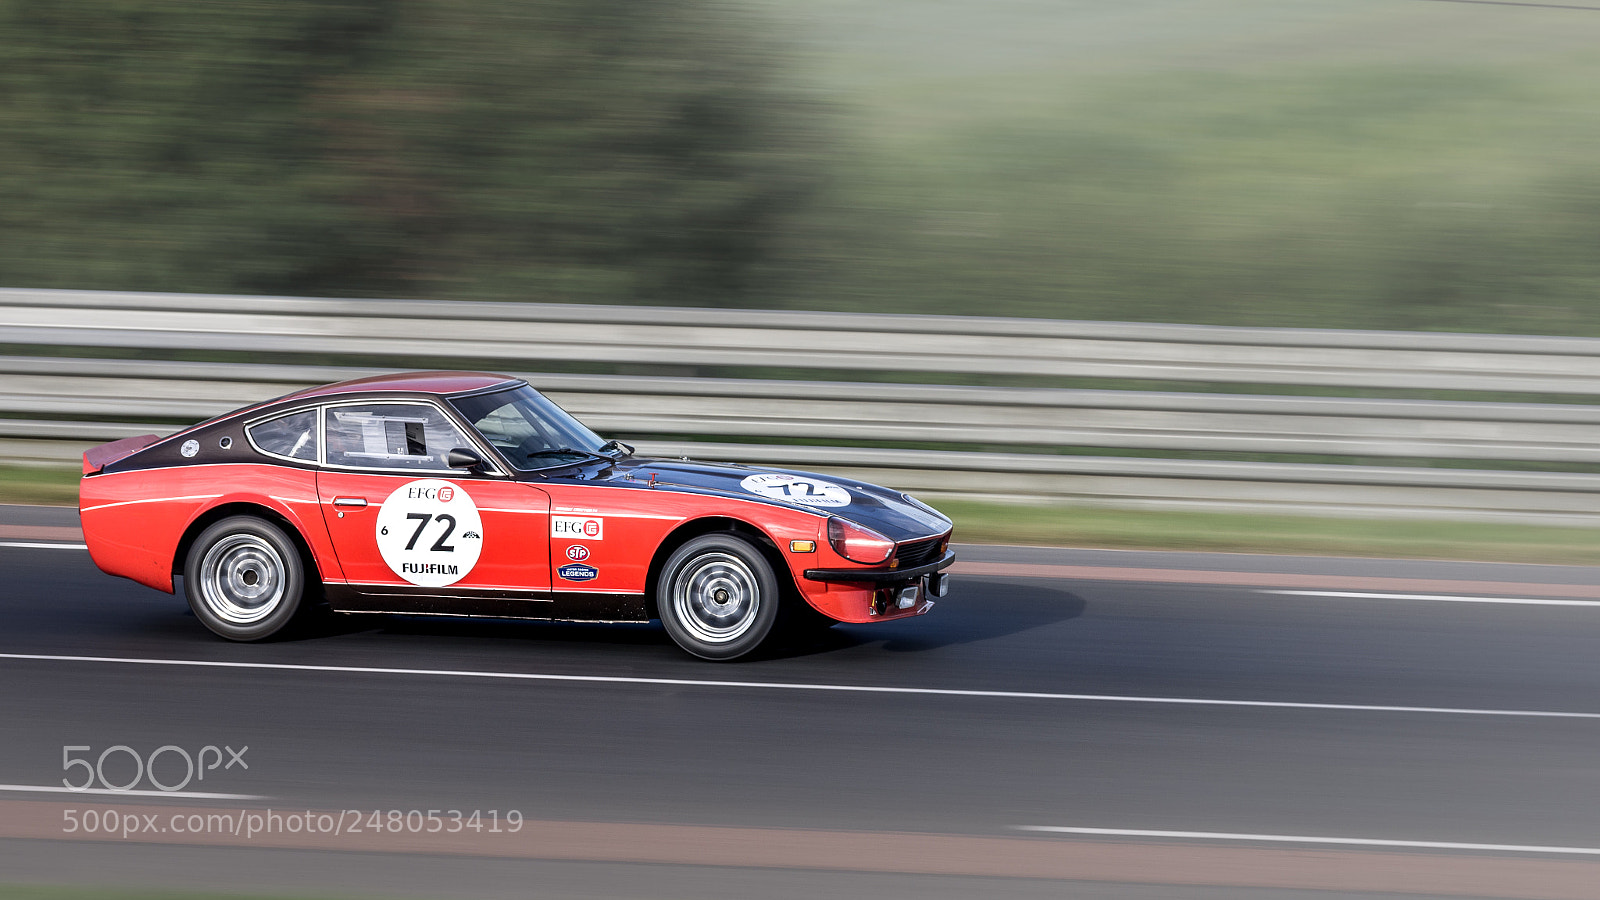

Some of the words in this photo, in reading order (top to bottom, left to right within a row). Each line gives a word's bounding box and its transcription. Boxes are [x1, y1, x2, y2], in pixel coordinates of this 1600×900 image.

[408, 487, 437, 500] EFG
[766, 482, 826, 496] 72
[380, 525, 389, 536] 6
[404, 512, 457, 552] 72
[555, 520, 582, 534] EFG
[569, 546, 587, 559] STP
[402, 562, 459, 575] FUJIFILM
[561, 570, 595, 578] LEGENDS
